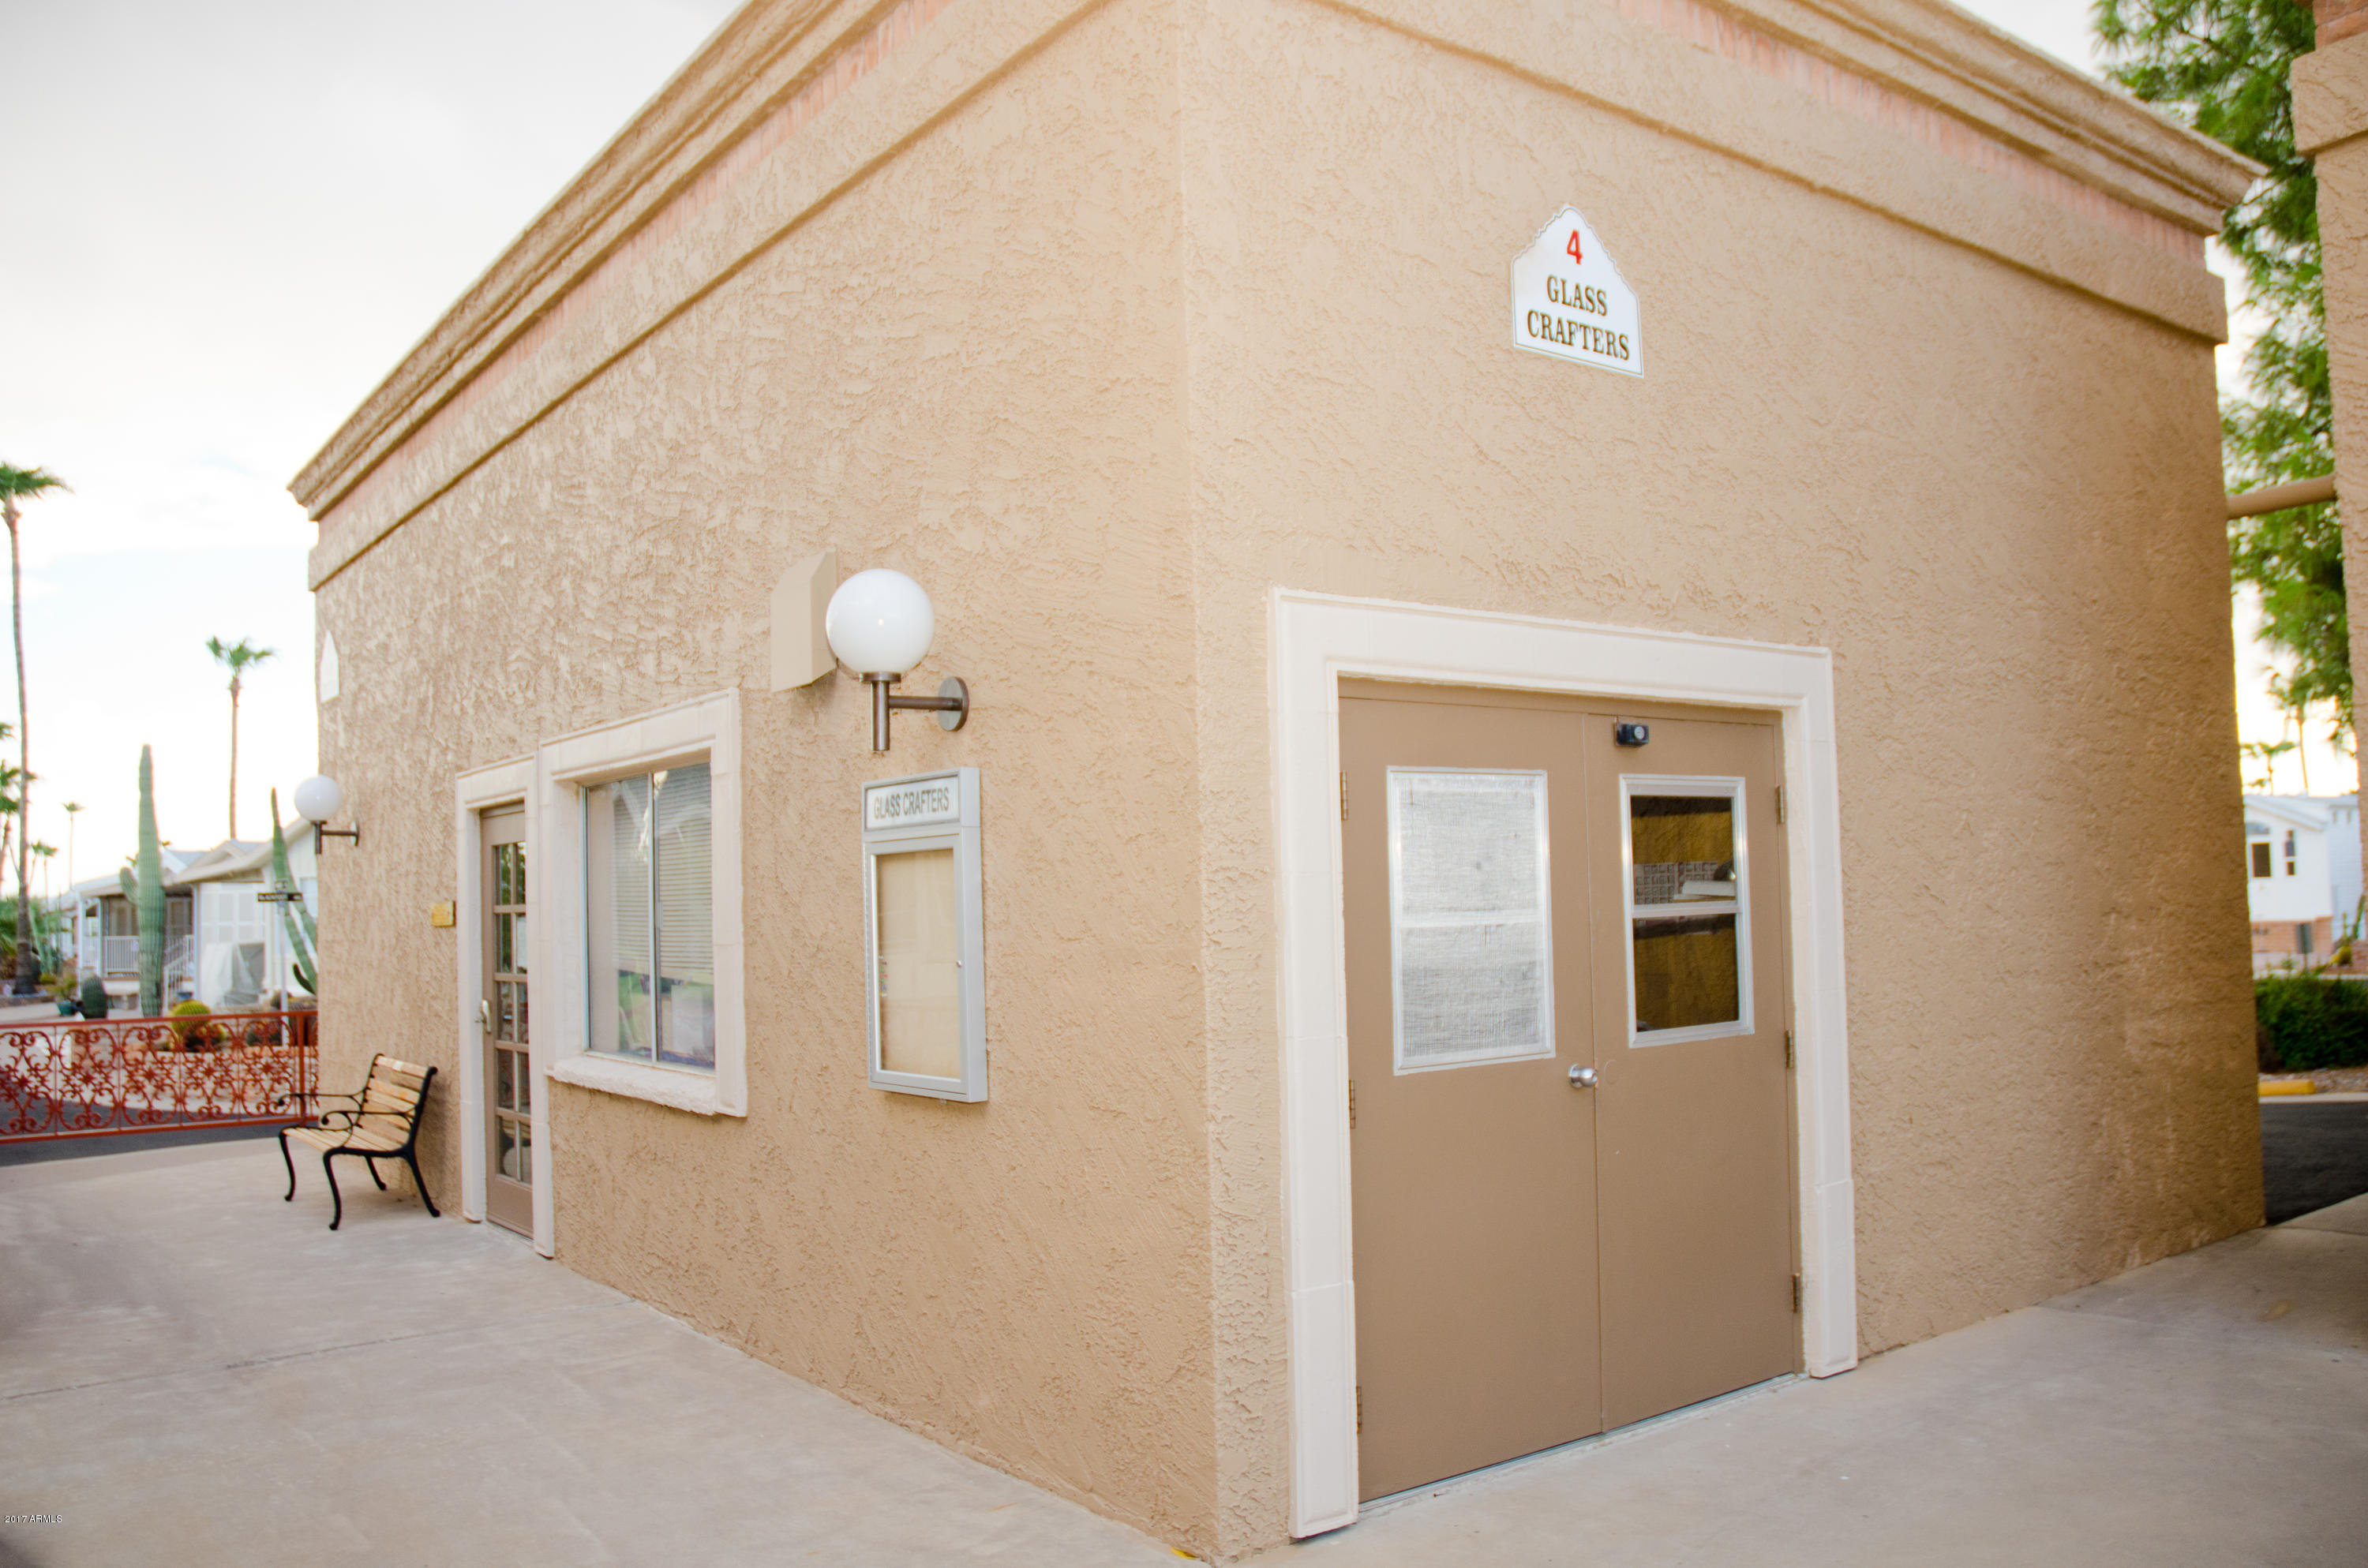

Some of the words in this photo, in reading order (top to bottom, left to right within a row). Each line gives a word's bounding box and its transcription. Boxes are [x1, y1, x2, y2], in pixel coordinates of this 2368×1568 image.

[1566, 229, 1583, 265] 4
[1546, 274, 1608, 316] GLASS
[1527, 309, 1630, 361] CRAFTERS
[874, 793, 901, 820] GLASS
[902, 787, 950, 816] CRAFTERS
